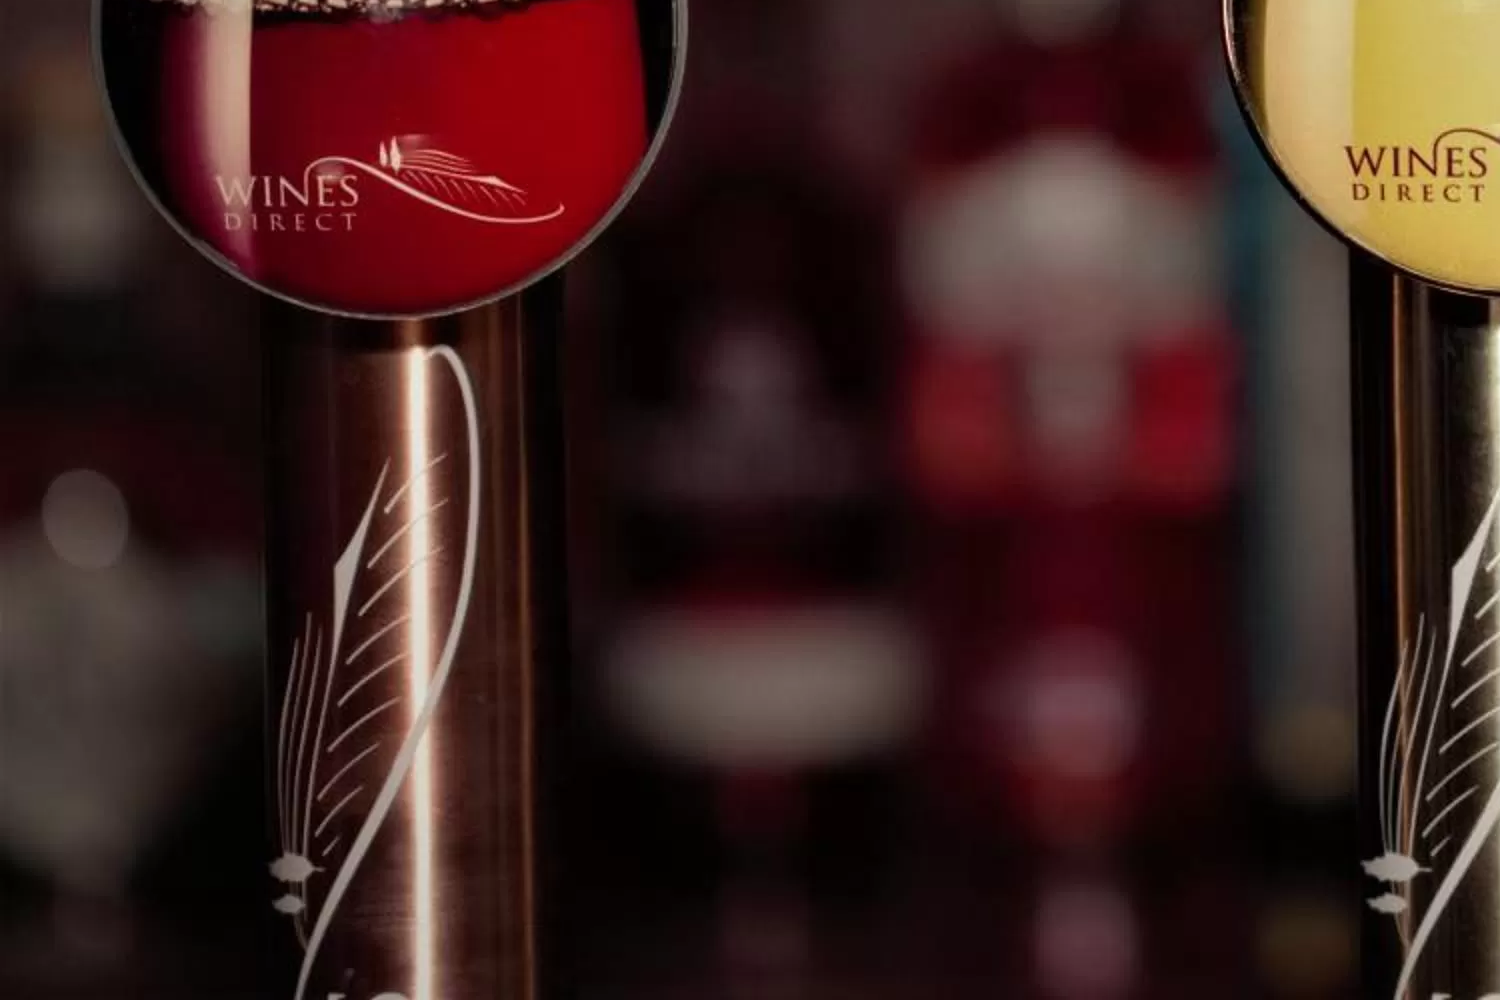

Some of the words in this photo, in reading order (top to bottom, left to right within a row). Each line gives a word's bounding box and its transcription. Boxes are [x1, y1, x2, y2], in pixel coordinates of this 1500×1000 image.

[1345, 145, 1488, 178] WINES
[215, 174, 360, 208] WINES
[1352, 183, 1485, 203] DIRECT
[223, 212, 358, 232] DIRECT
